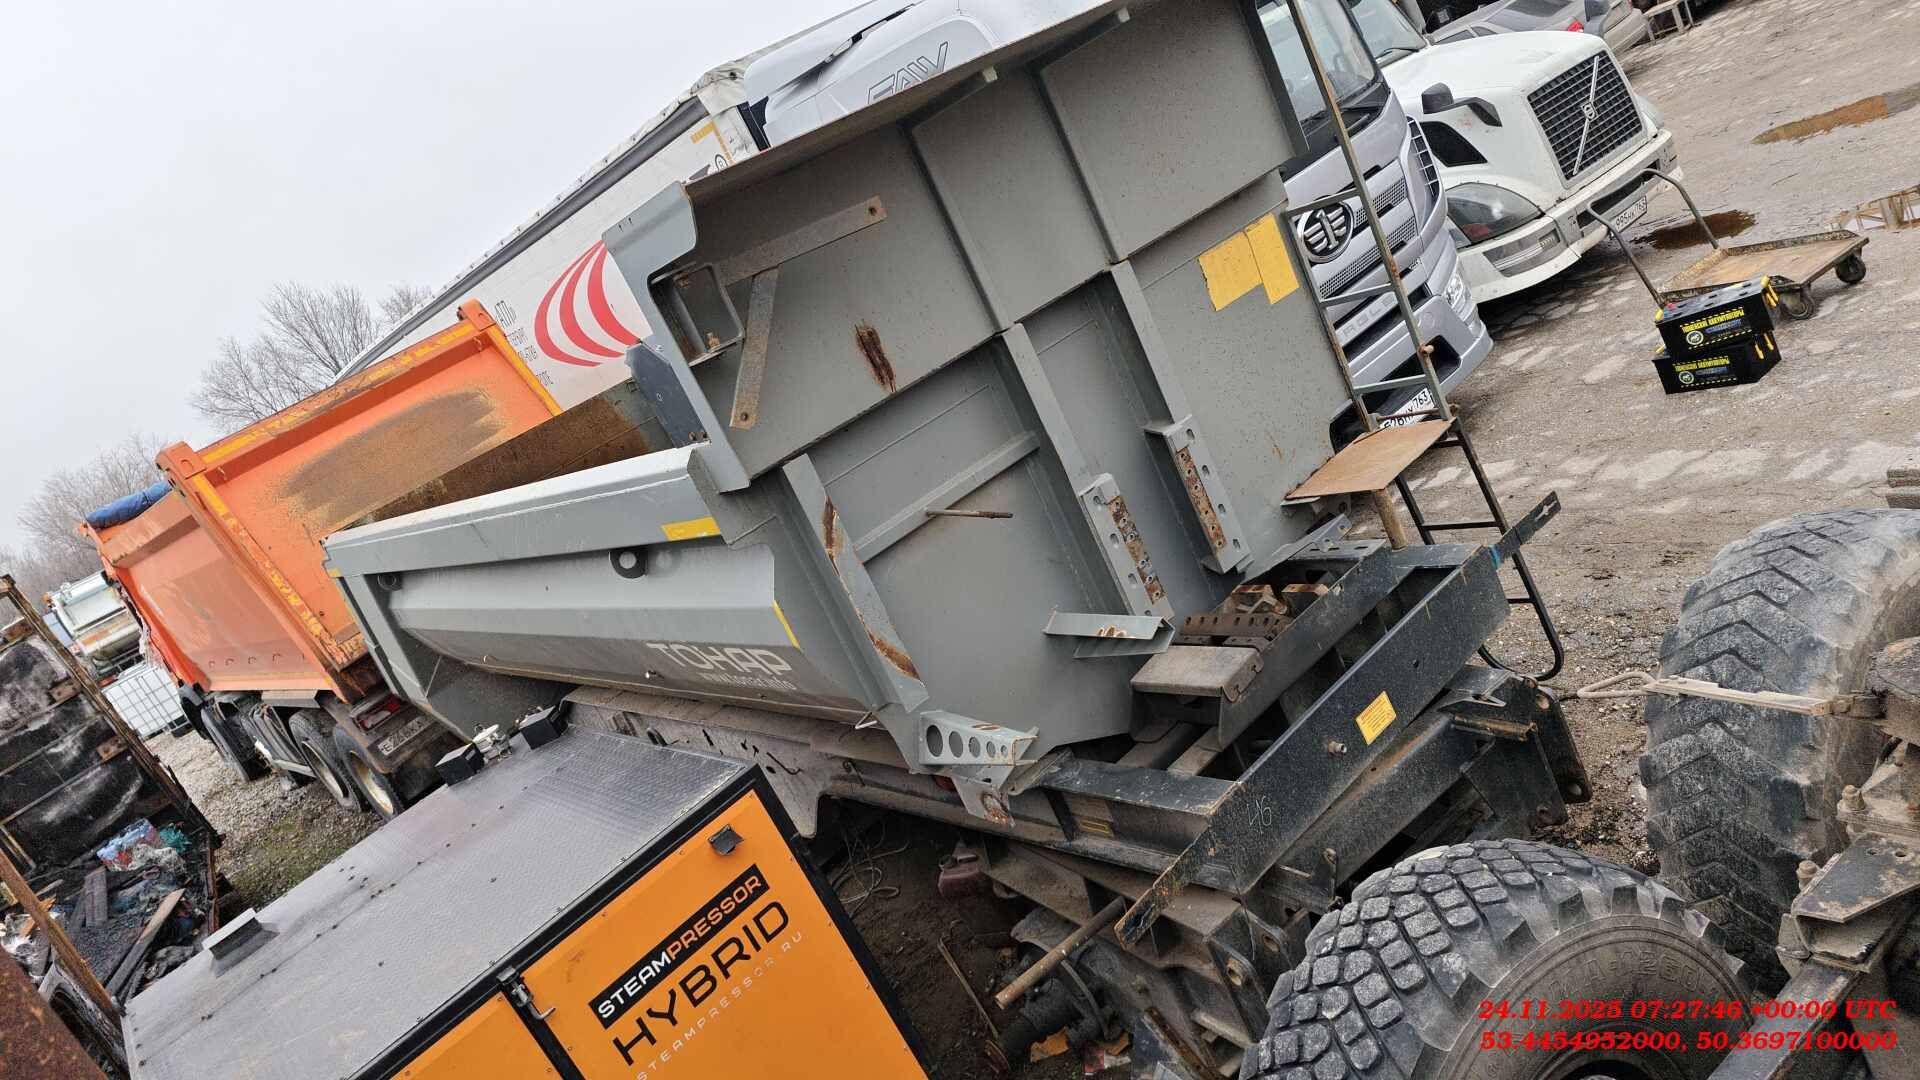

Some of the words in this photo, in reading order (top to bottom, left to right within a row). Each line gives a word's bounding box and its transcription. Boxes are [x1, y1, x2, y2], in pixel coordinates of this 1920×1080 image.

[646, 642, 792, 676] ТОНАР
[598, 875, 762, 1019] STEAMPRESSOR
[612, 901, 789, 1067] HYBRID
